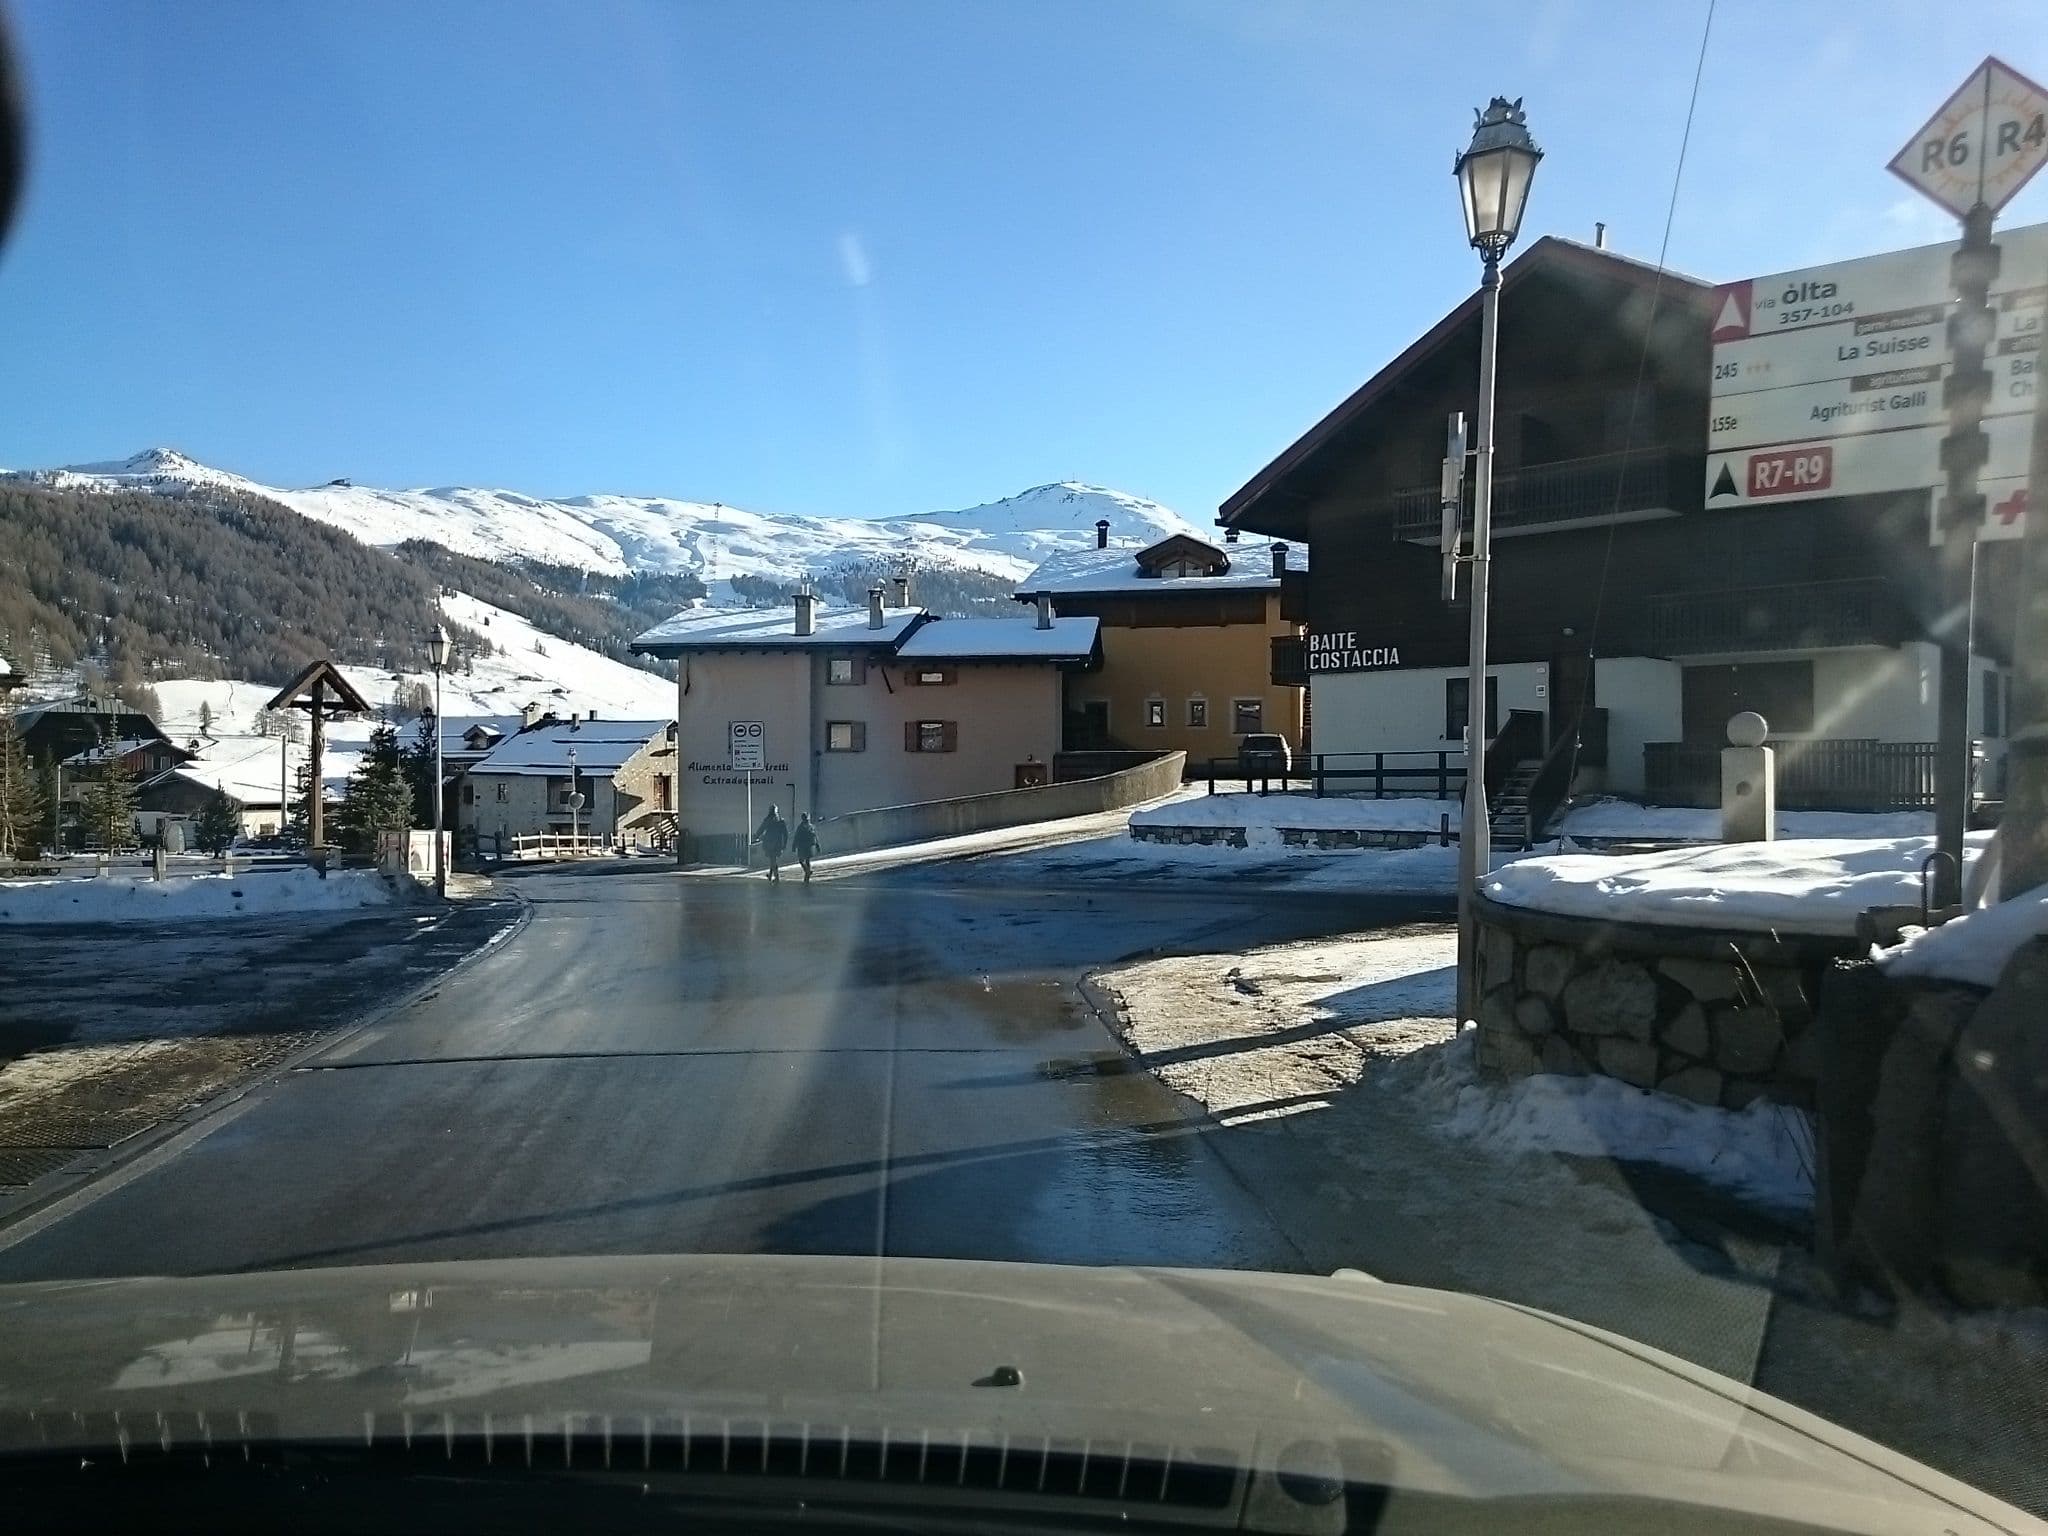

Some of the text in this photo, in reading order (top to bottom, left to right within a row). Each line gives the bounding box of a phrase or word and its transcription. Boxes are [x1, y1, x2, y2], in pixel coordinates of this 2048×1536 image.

[1922, 132, 1969, 172] R6
[1755, 298, 1775, 309] via
[1779, 301, 1854, 325] 357-104
[1838, 335, 1930, 361] La Suisse
[1715, 363, 1737, 380] 245
[1810, 391, 1926, 420] Agriturist Galli
[1711, 416, 1737, 432] 155e
[1754, 455, 1822, 489] R7-R9
[1310, 632, 1357, 651] BAITE
[1310, 647, 1399, 669] COSTACCIA
